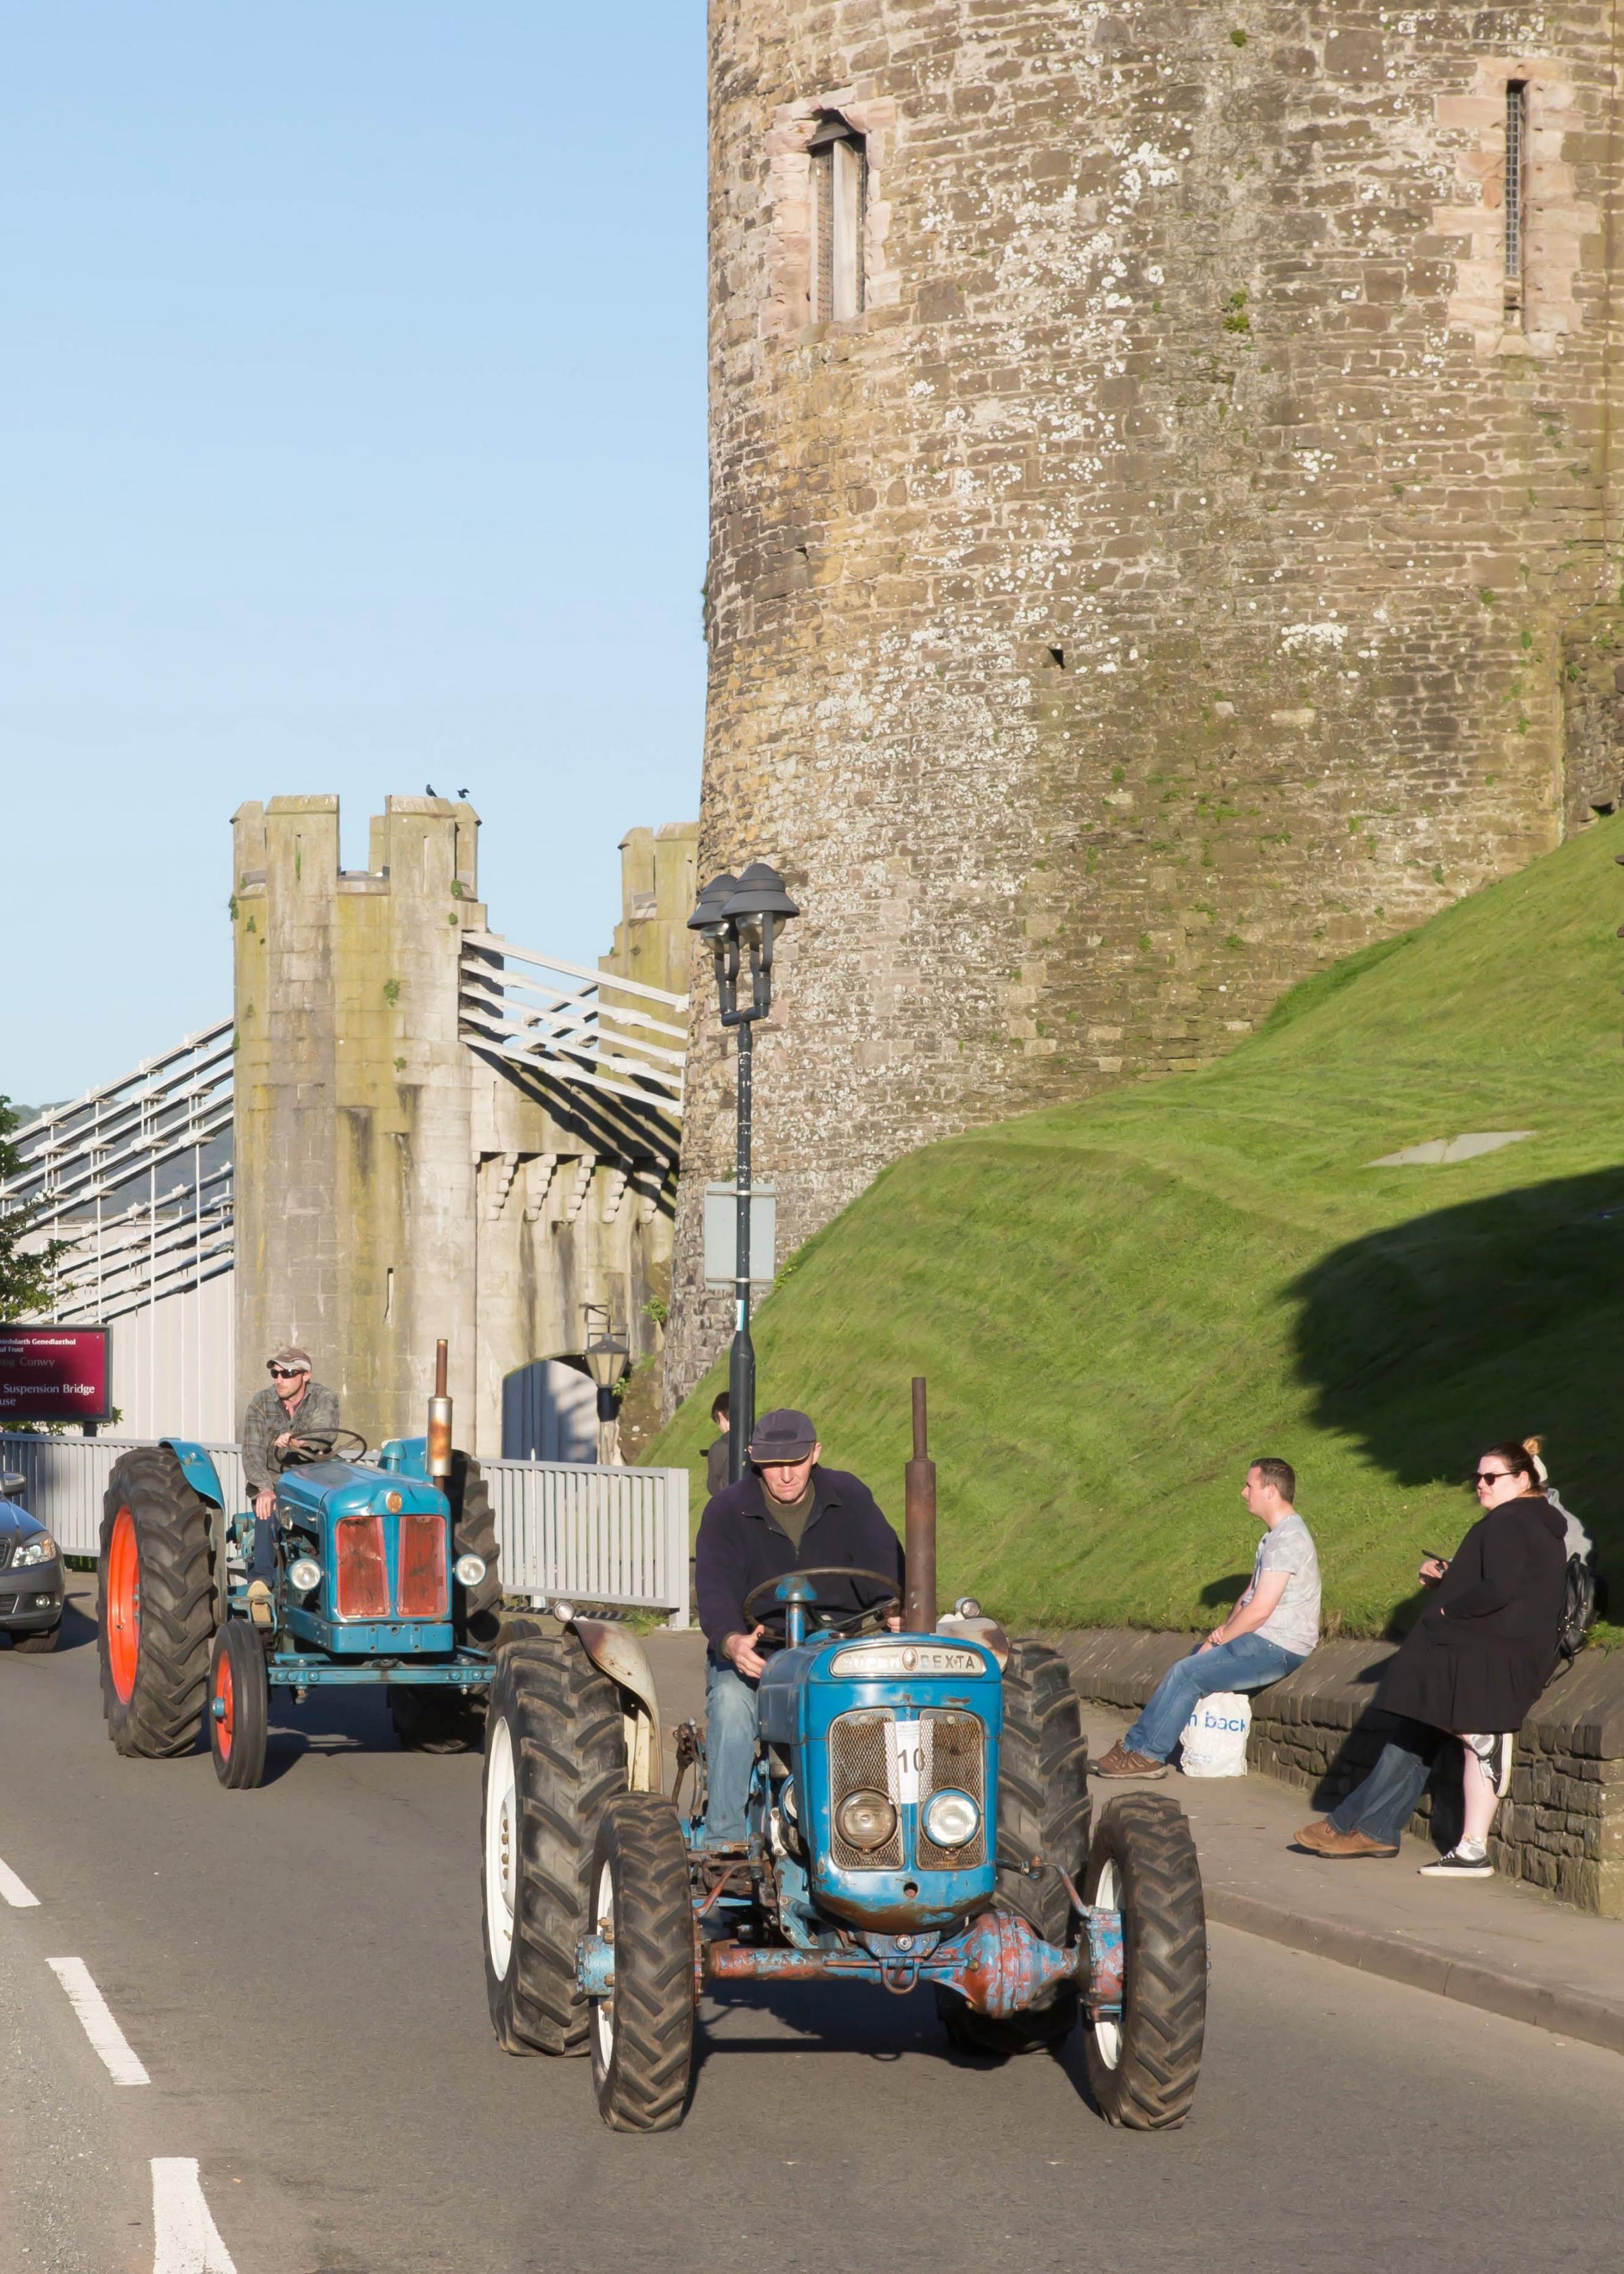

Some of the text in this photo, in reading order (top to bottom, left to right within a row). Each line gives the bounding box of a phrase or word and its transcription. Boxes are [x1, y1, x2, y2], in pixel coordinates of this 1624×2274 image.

[19, 1356, 55, 1368] Conwy
[3, 1383, 95, 1395] Suspension Bridge
[842, 1654, 975, 1669] SUPER DEXTA
[897, 1747, 925, 1773] 10
